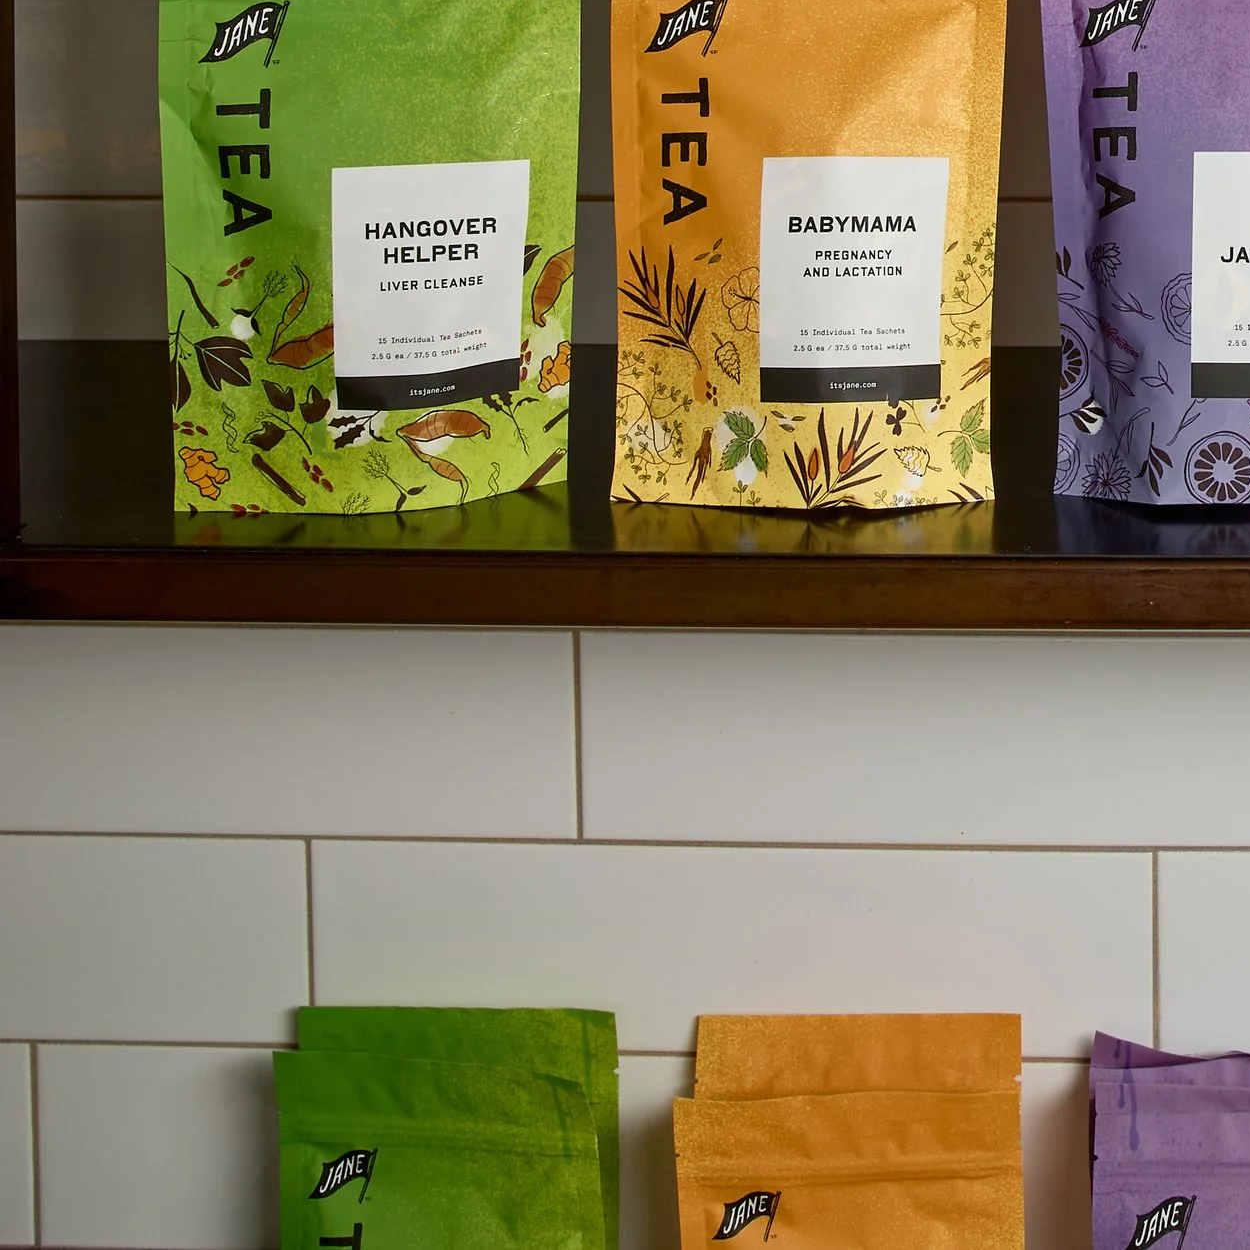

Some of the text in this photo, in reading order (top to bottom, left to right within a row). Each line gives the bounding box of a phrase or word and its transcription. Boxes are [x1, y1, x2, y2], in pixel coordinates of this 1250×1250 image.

[214, 8, 274, 57] JANE
[657, 0, 714, 46] JANE
[661, 78, 710, 225] TEA
[1092, 72, 1138, 220] TEA
[216, 88, 272, 236] TEA
[366, 218, 496, 240] HANGOVER
[789, 216, 916, 233] BABYMAMA
[384, 244, 478, 264] HELPER
[816, 250, 892, 260] PREGNANCY
[803, 266, 902, 277] AND LACTATION
[380, 276, 483, 291] LIVER CLEANSE
[455, 329, 481, 338] Sachets
[441, 347, 460, 356] total
[464, 343, 486, 351] weight
[410, 385, 455, 396] itsjane.com
[830, 382, 876, 390] itsjane.com
[320, 1154, 365, 1193] JANE
[723, 1196, 768, 1234] JANE
[1135, 1202, 1183, 1246] JANE
